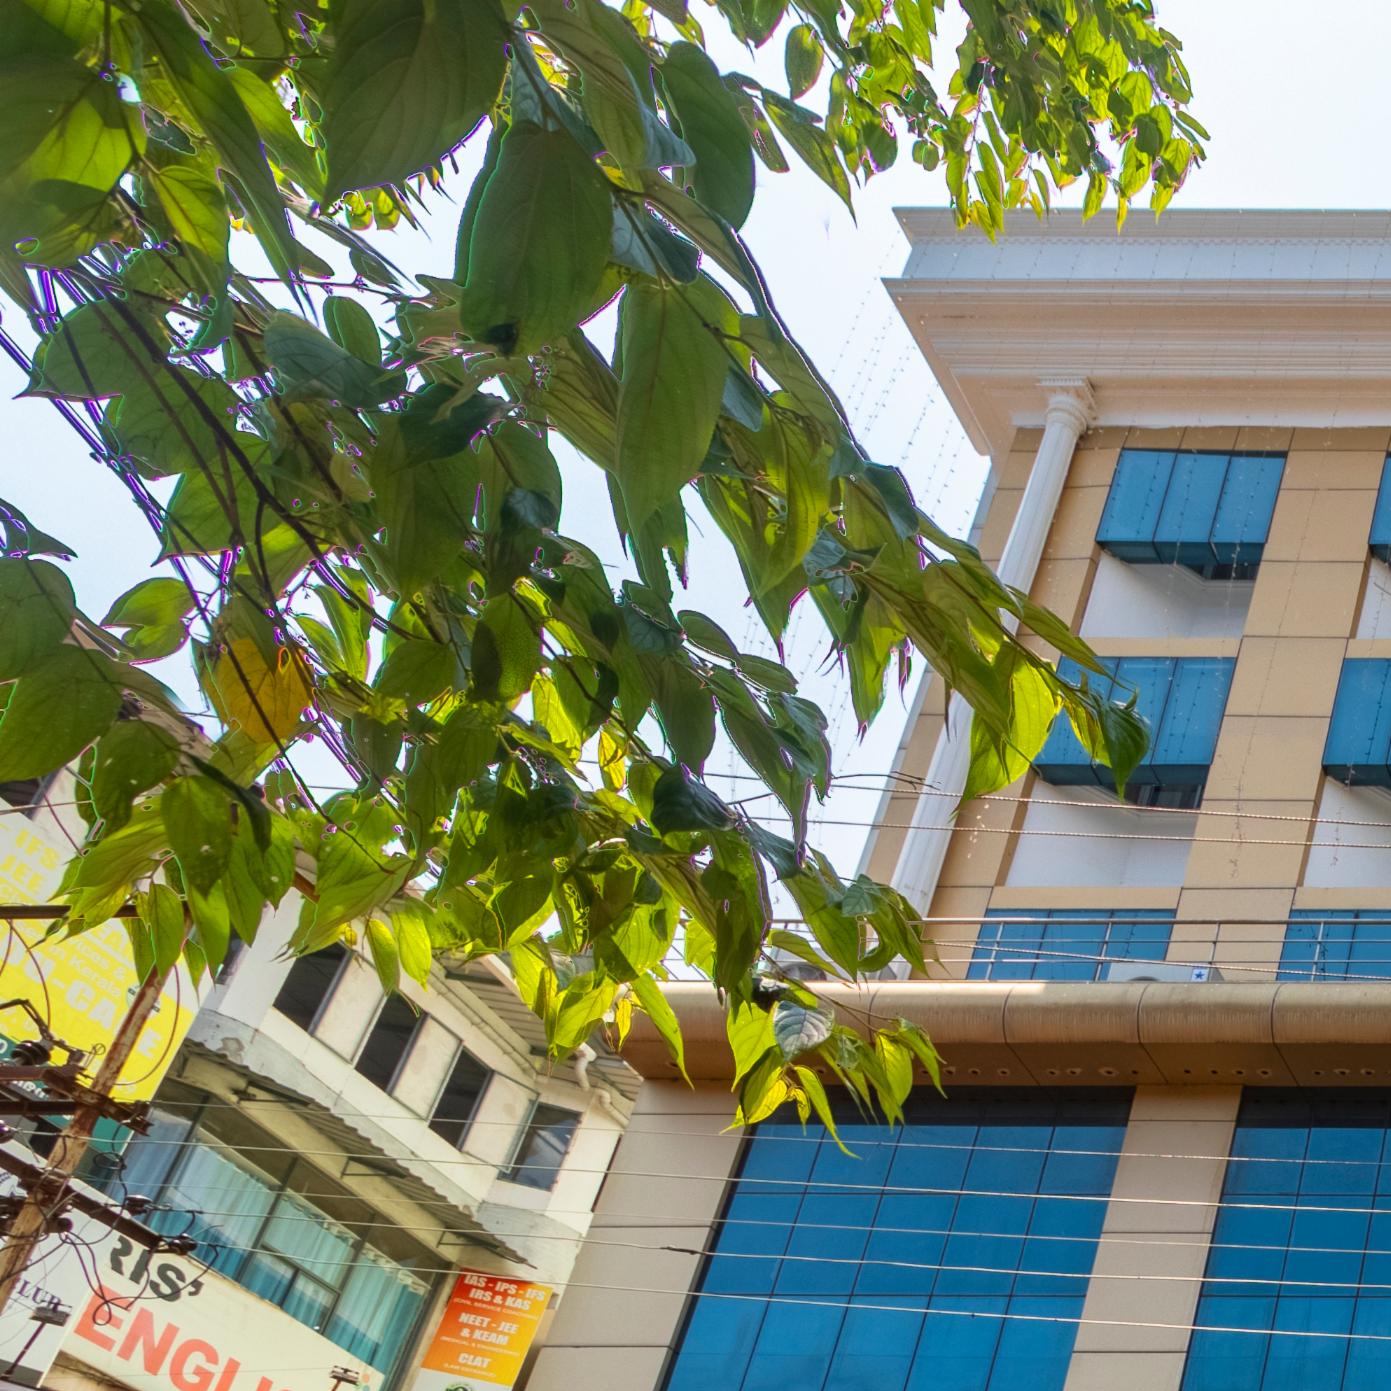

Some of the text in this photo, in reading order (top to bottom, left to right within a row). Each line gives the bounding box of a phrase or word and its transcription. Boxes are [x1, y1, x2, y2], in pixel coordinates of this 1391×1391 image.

[463, 1274, 487, 1288] IAS
[494, 1281, 518, 1294] IPS
[525, 1289, 546, 1302] IFS
[469, 1288, 532, 1311] IRS & KAS
[458, 1312, 490, 1328] NEET
[498, 1321, 519, 1334] JEE
[460, 1328, 509, 1345] & KEAM
[458, 1352, 493, 1368] CLAT
